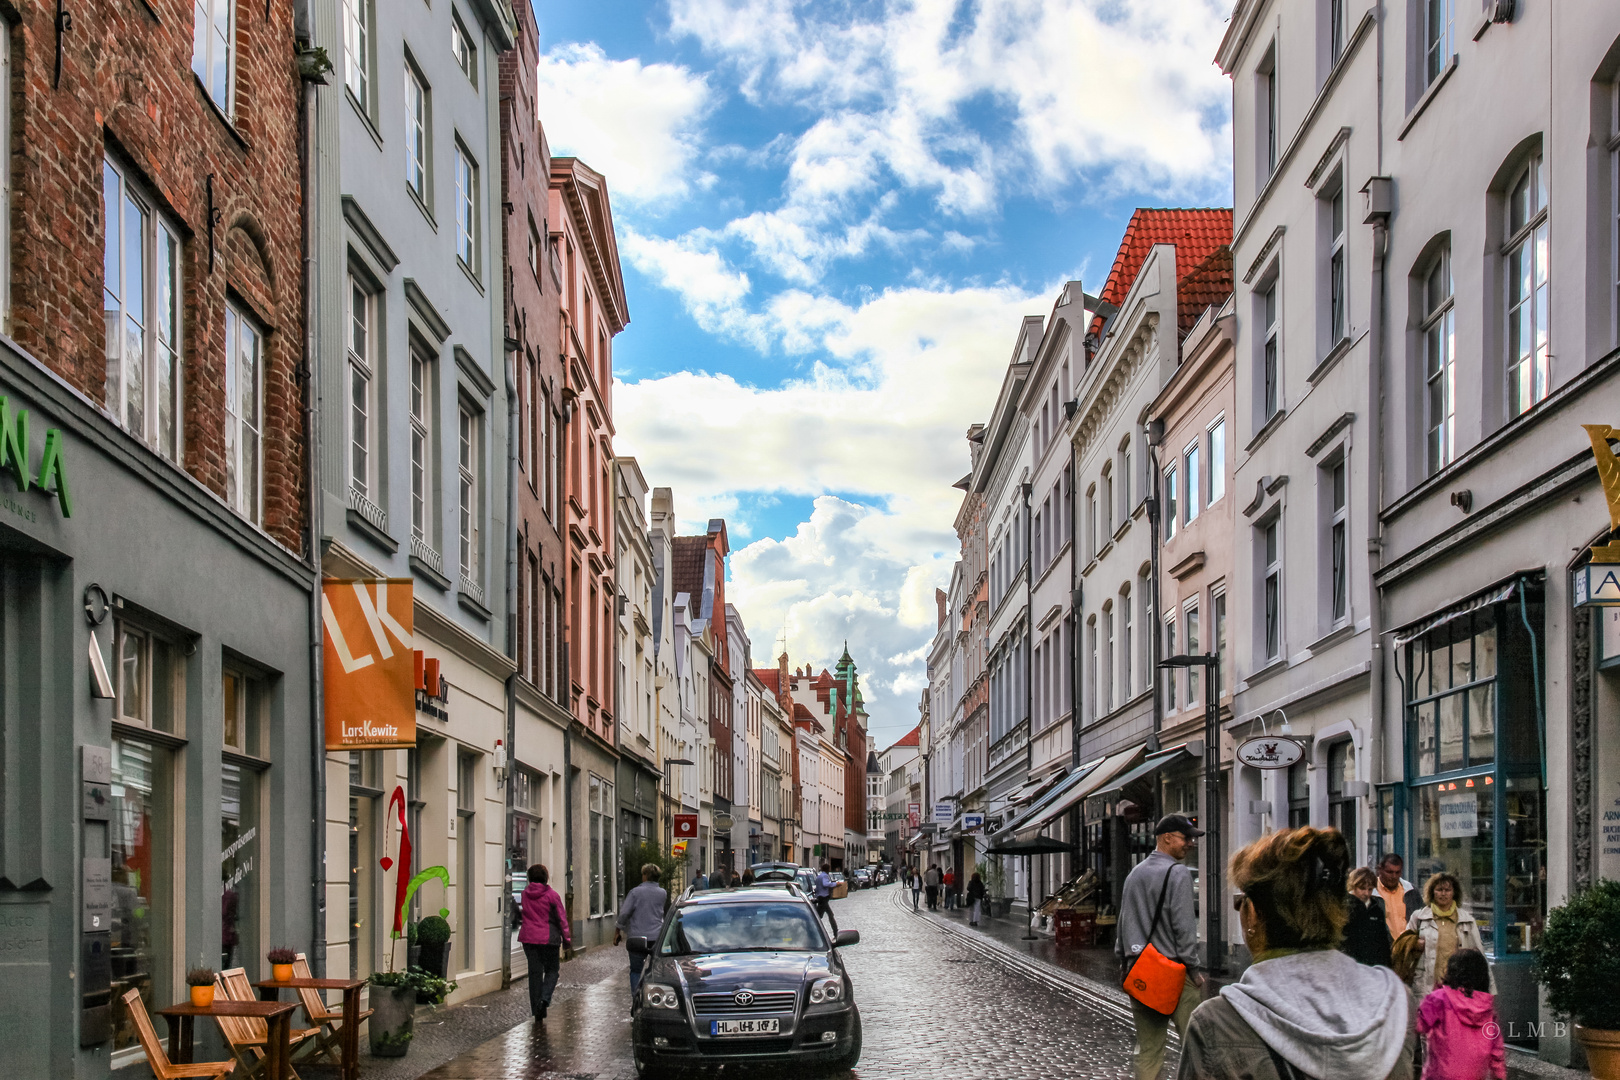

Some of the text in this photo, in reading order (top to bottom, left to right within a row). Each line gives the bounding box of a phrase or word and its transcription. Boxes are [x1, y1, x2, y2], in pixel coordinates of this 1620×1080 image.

[0, 497, 36, 523] OUNGE
[322, 578, 413, 674] LK
[341, 720, 398, 737] LarsKewitz
[717, 1021, 732, 1033] HL
